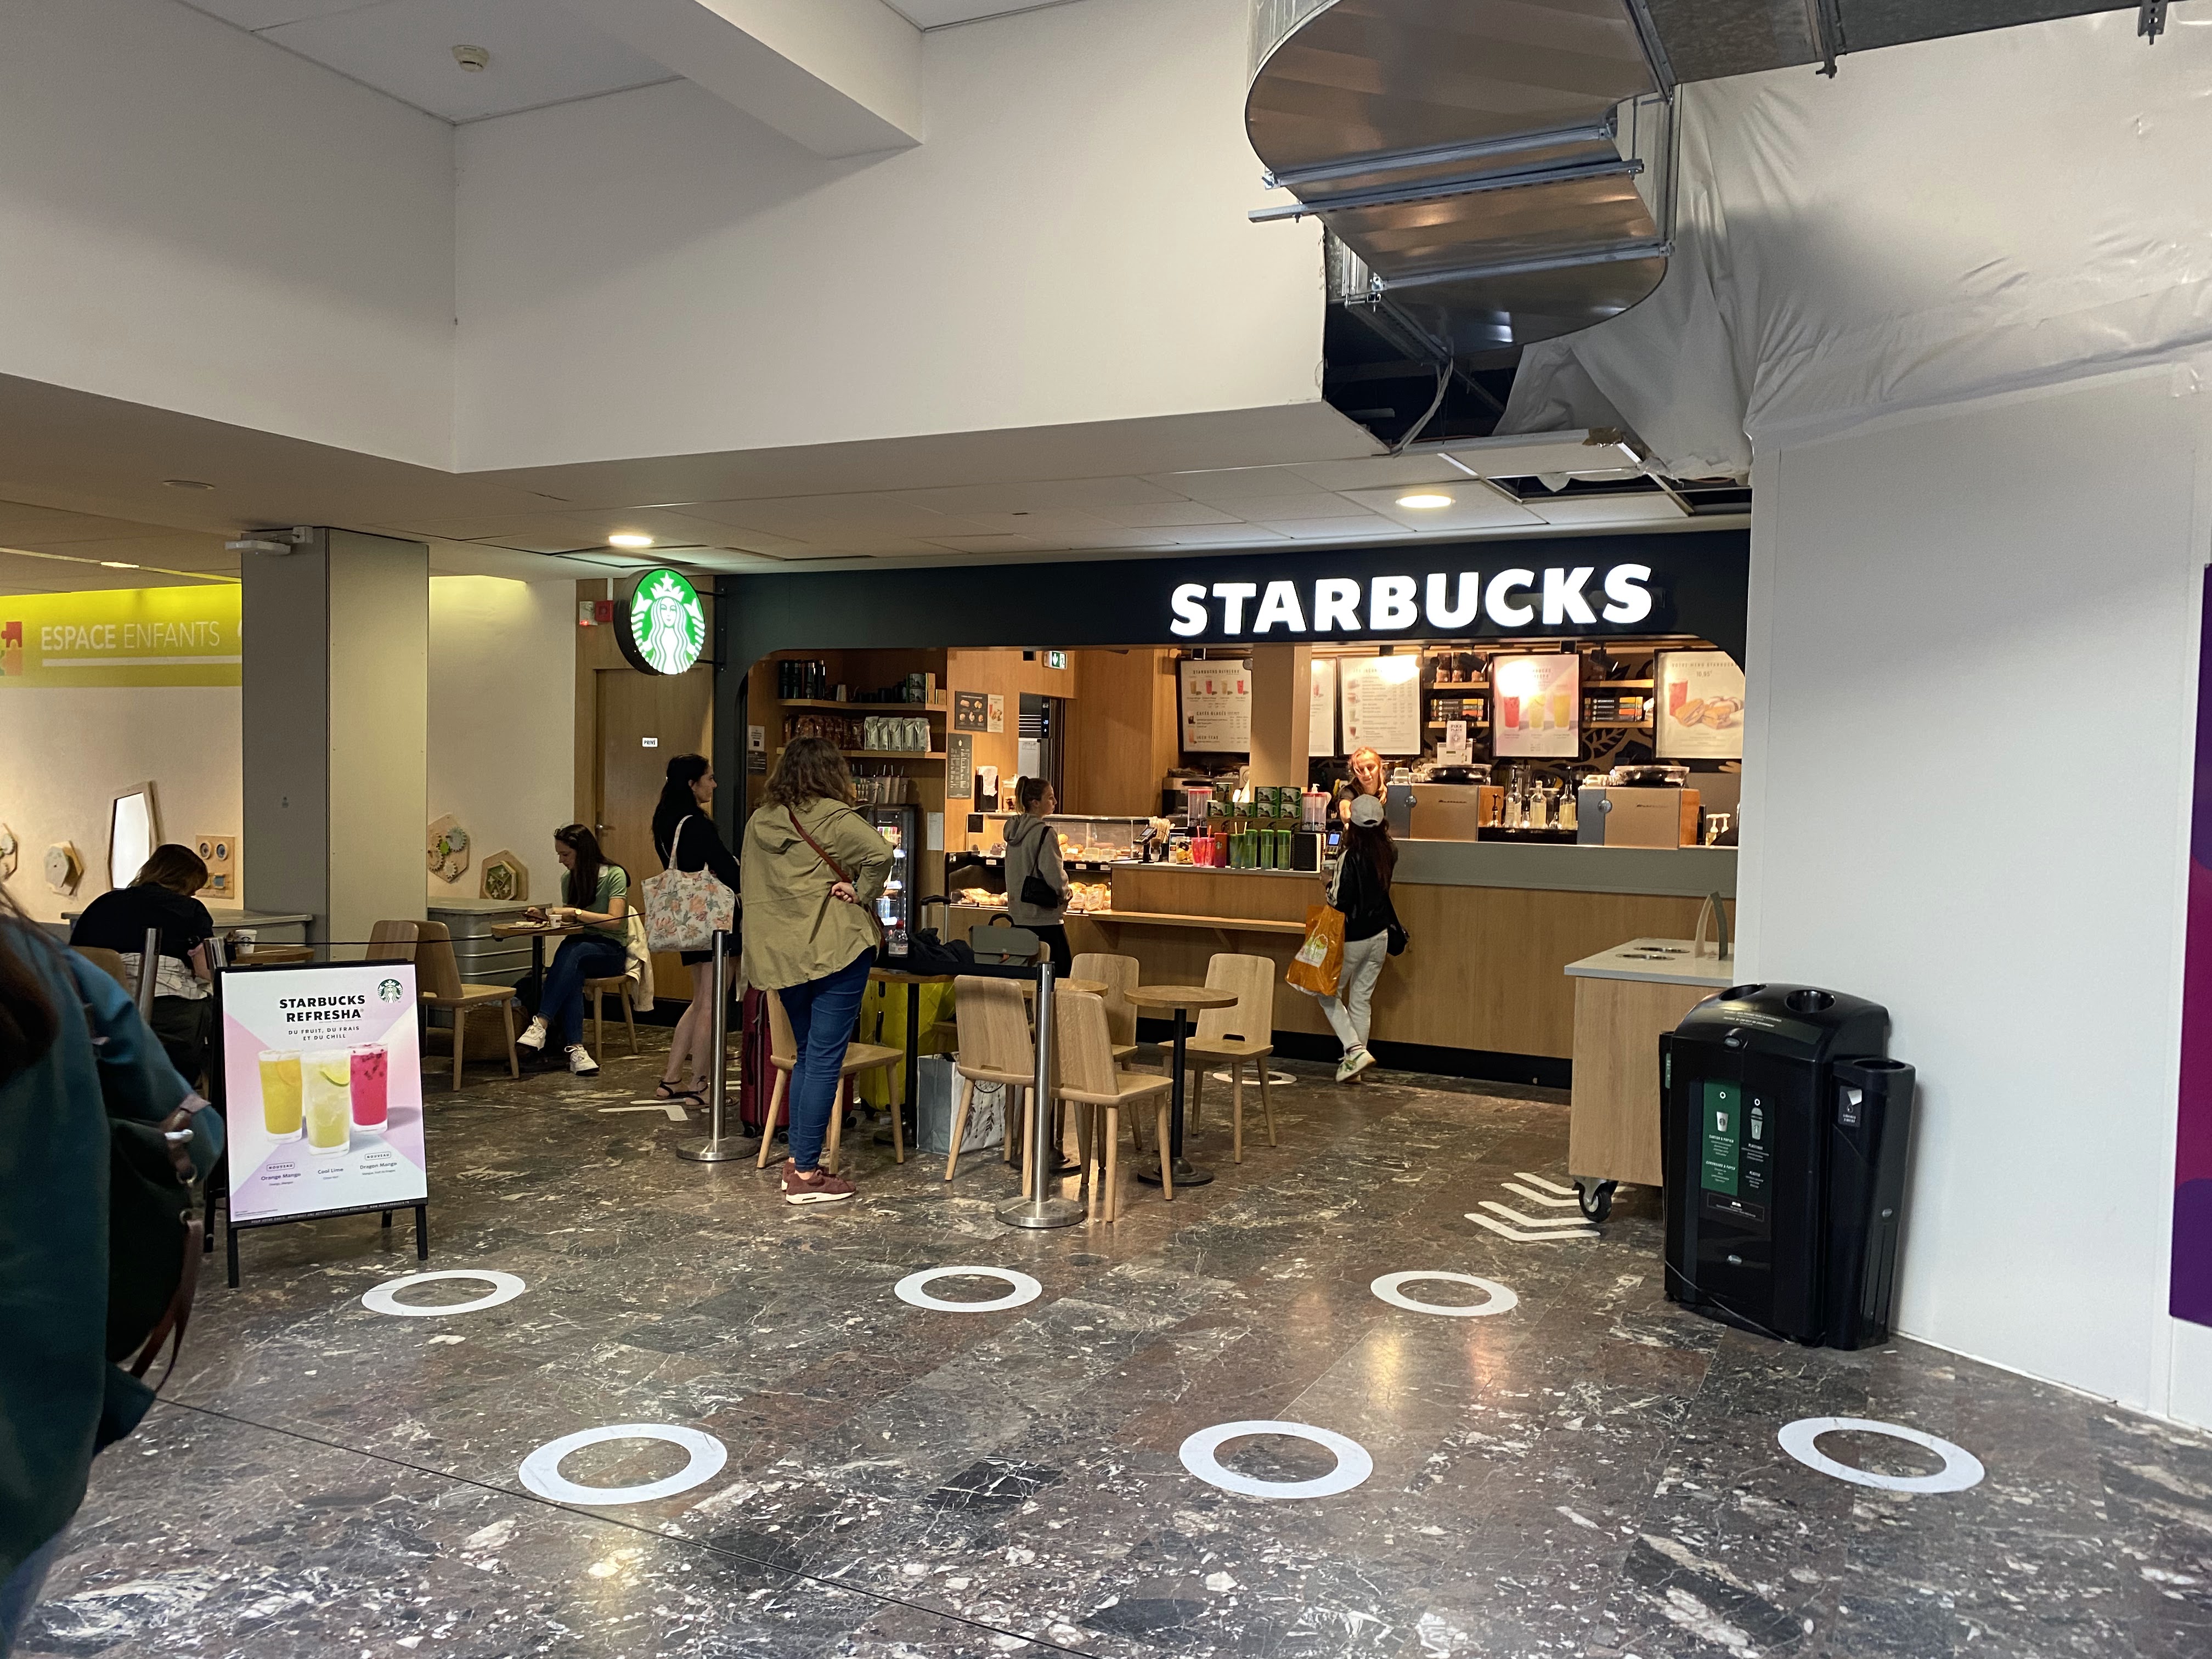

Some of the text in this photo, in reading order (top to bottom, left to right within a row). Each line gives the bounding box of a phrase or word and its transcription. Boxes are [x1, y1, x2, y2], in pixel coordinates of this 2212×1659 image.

[1170, 563, 1653, 637] STARBUCKS
[41, 624, 116, 651] ESPACE
[123, 620, 220, 649] ENFANTS
[279, 995, 365, 1009] STARBUCKS
[286, 1008, 362, 1023] REFRESHA
